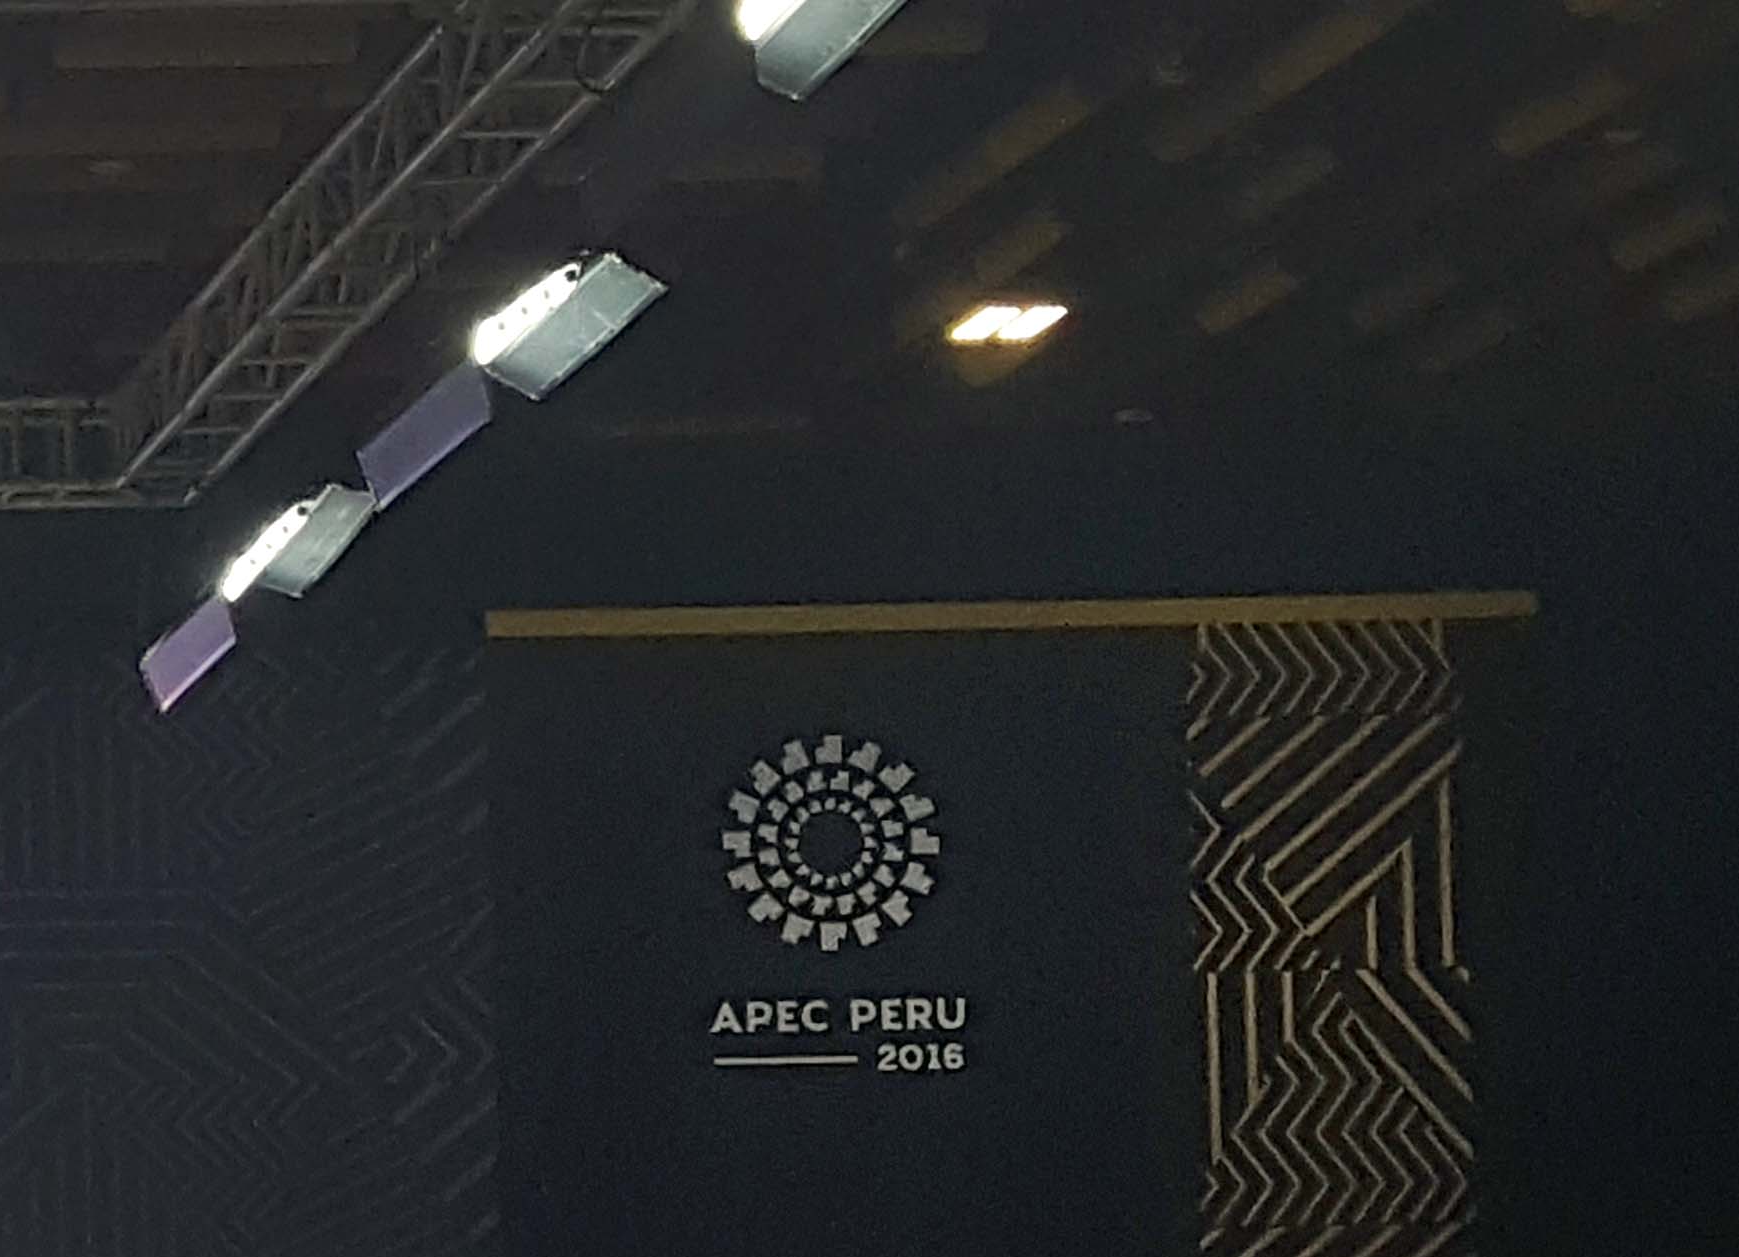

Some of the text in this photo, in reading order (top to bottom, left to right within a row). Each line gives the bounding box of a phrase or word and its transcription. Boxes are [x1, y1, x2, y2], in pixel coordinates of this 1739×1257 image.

[710, 998, 966, 1033] APEC PERU
[877, 1044, 965, 1071] 2016
